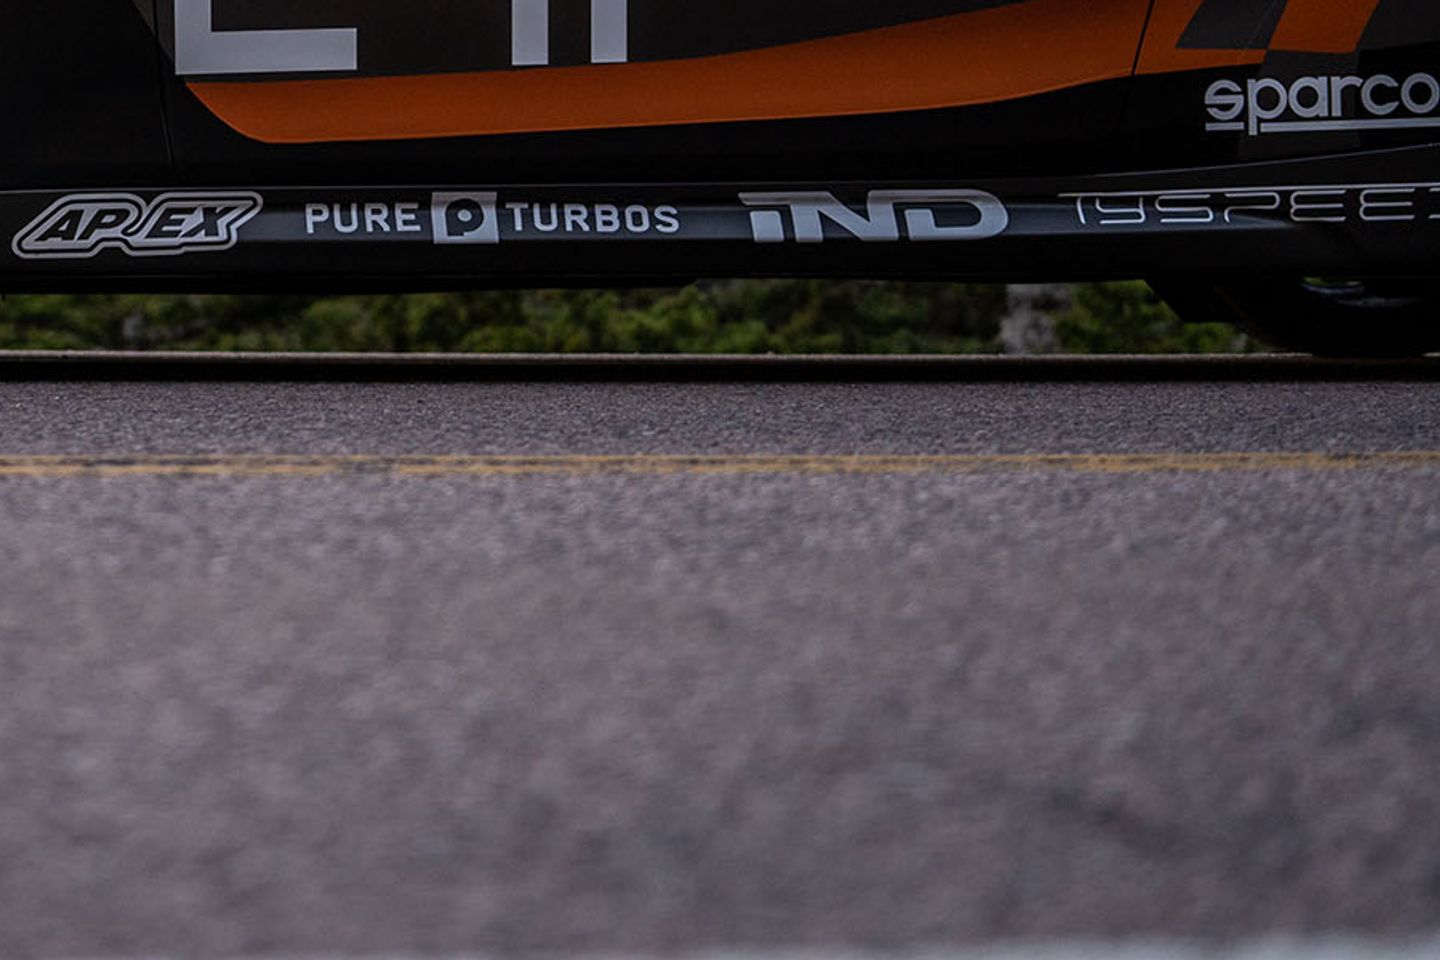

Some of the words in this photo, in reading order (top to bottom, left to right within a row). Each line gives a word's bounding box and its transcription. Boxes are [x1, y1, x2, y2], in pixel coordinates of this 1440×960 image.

[1204, 72, 1440, 136] sparco
[23, 199, 257, 251] APEX
[305, 202, 421, 234] PURE
[505, 201, 680, 233] TURBOS
[1058, 182, 1440, 224] TYSPEE
